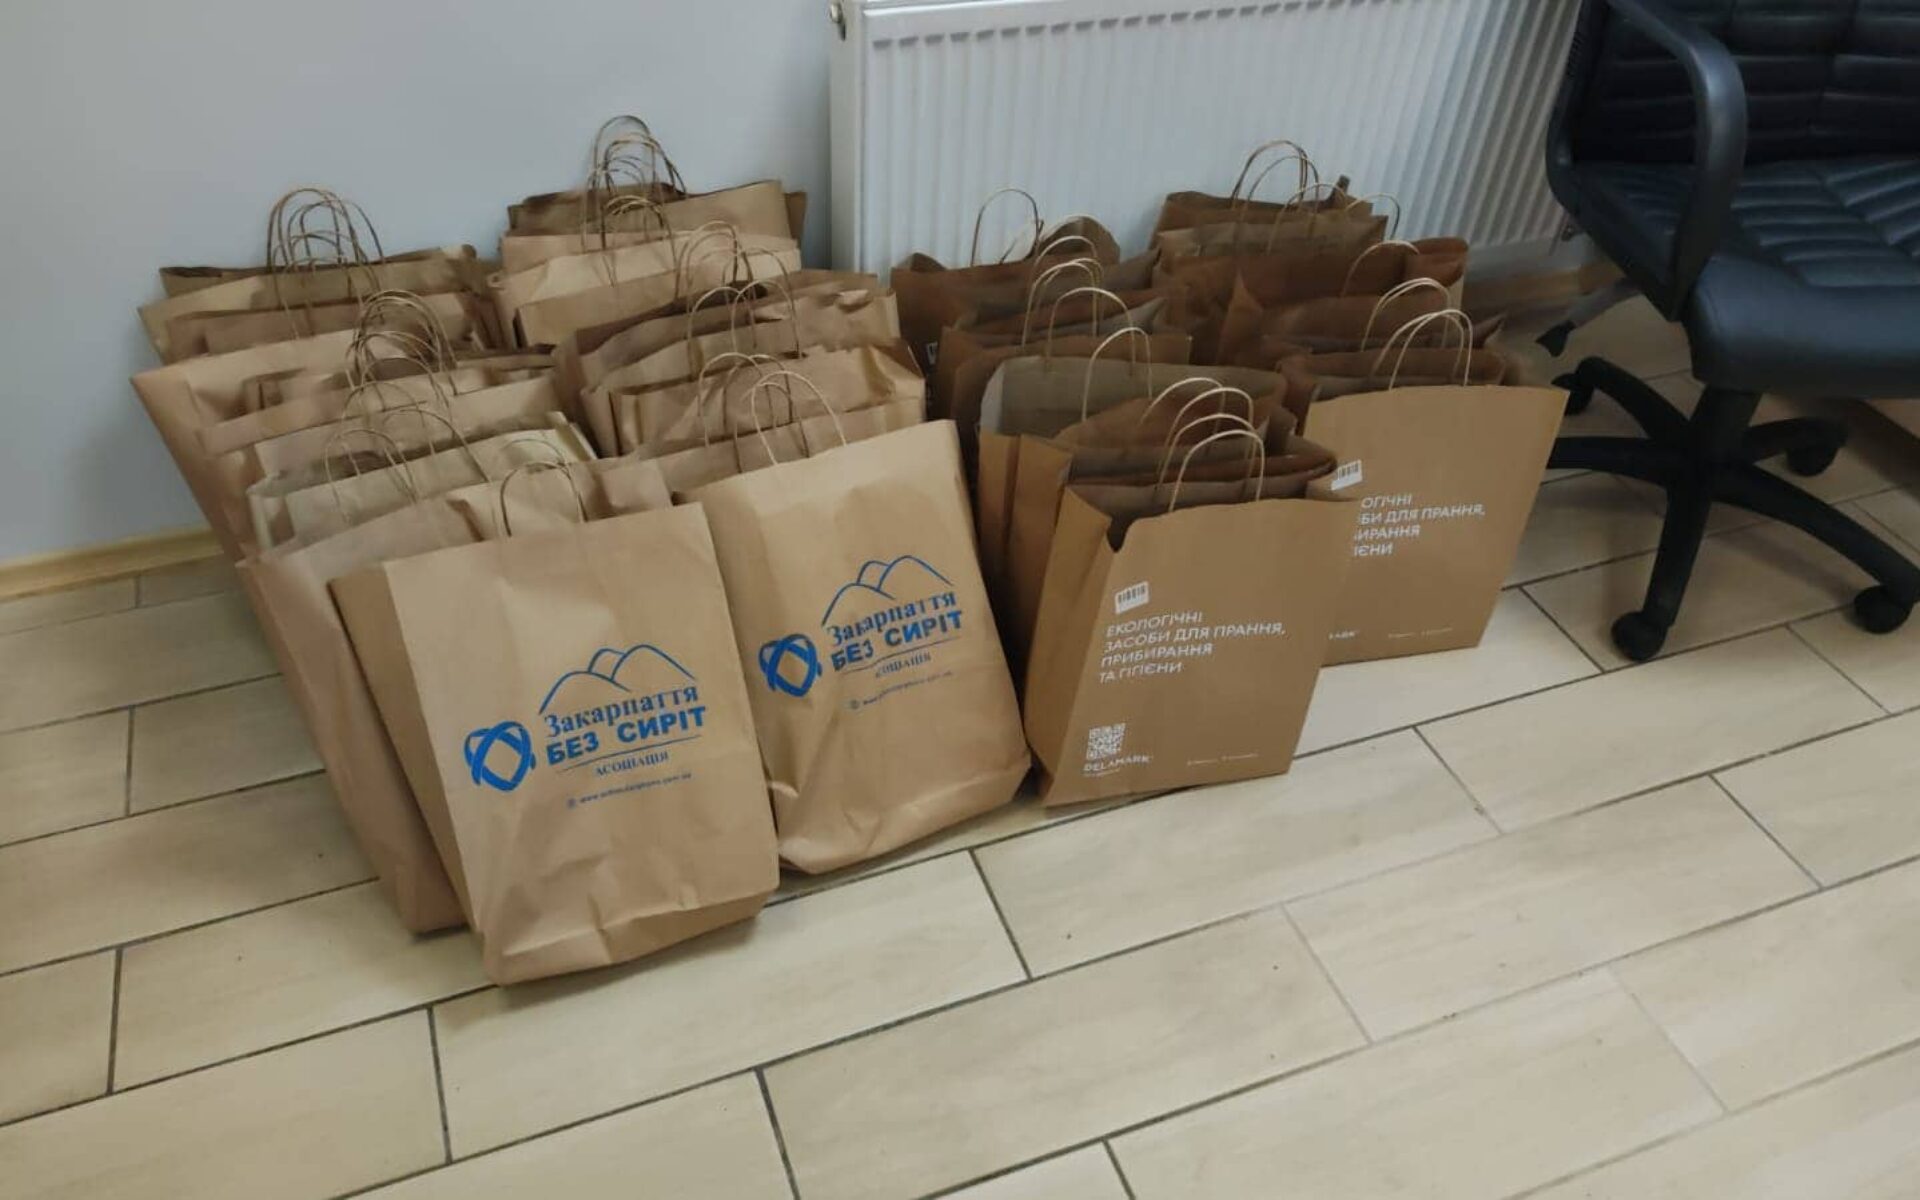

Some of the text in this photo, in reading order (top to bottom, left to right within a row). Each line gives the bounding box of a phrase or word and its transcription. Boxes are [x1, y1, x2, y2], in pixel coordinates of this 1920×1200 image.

[1385, 509, 1418, 523] ДЛЯ
[1354, 525, 1421, 540] ИРАННЯ
[1104, 623, 1286, 652] ЗАСОБИ ДЛЯ ПРАННЯ,
[1106, 612, 1203, 638] ЕКОЛОГІЧНІ
[831, 610, 962, 672] БЕЗ СИРІТ
[1101, 643, 1214, 668] ПРИБИРАННЯ
[1100, 662, 1183, 683] ТА ГІГІЄНИ
[544, 686, 699, 737] Закарпаття
[546, 706, 706, 765] БЕЗ СИРІТ
